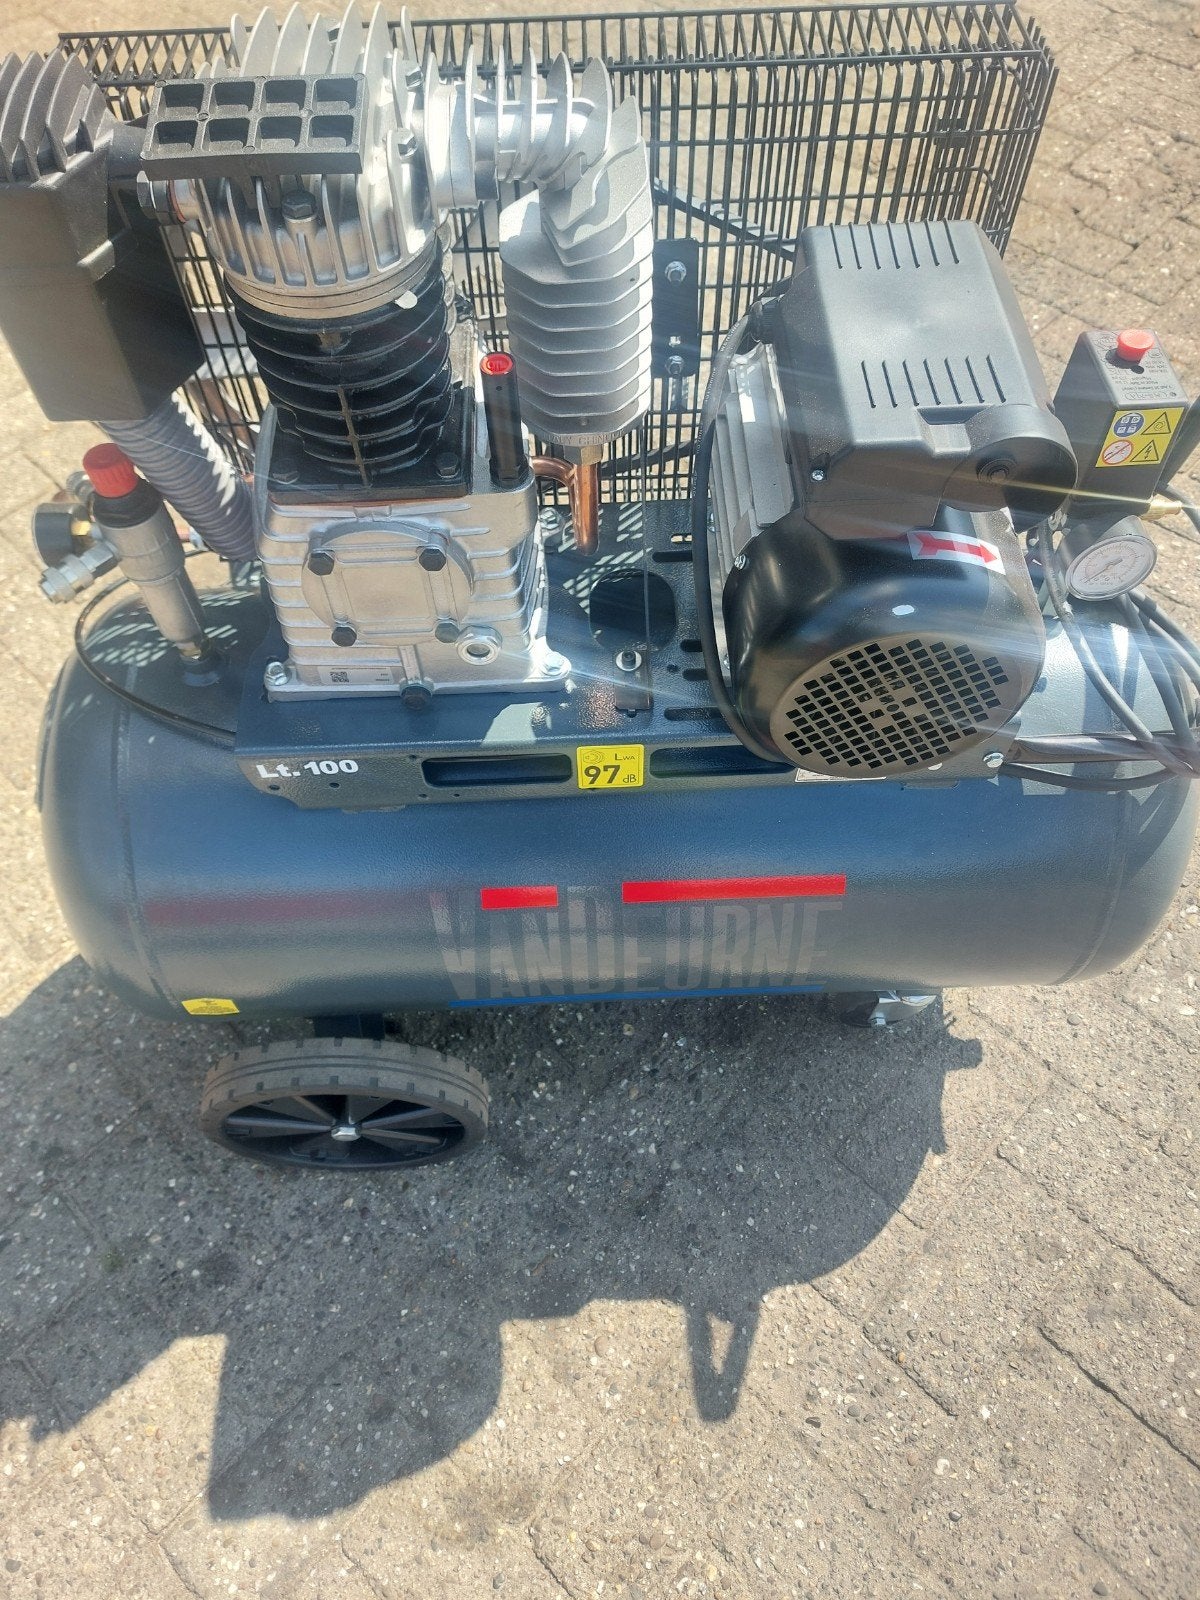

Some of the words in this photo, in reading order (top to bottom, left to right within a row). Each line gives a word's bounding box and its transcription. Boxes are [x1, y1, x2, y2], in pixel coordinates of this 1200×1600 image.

[256, 763, 301, 778] Lt.
[304, 760, 359, 775] 100
[584, 765, 621, 785] 97
[622, 773, 637, 783] dB
